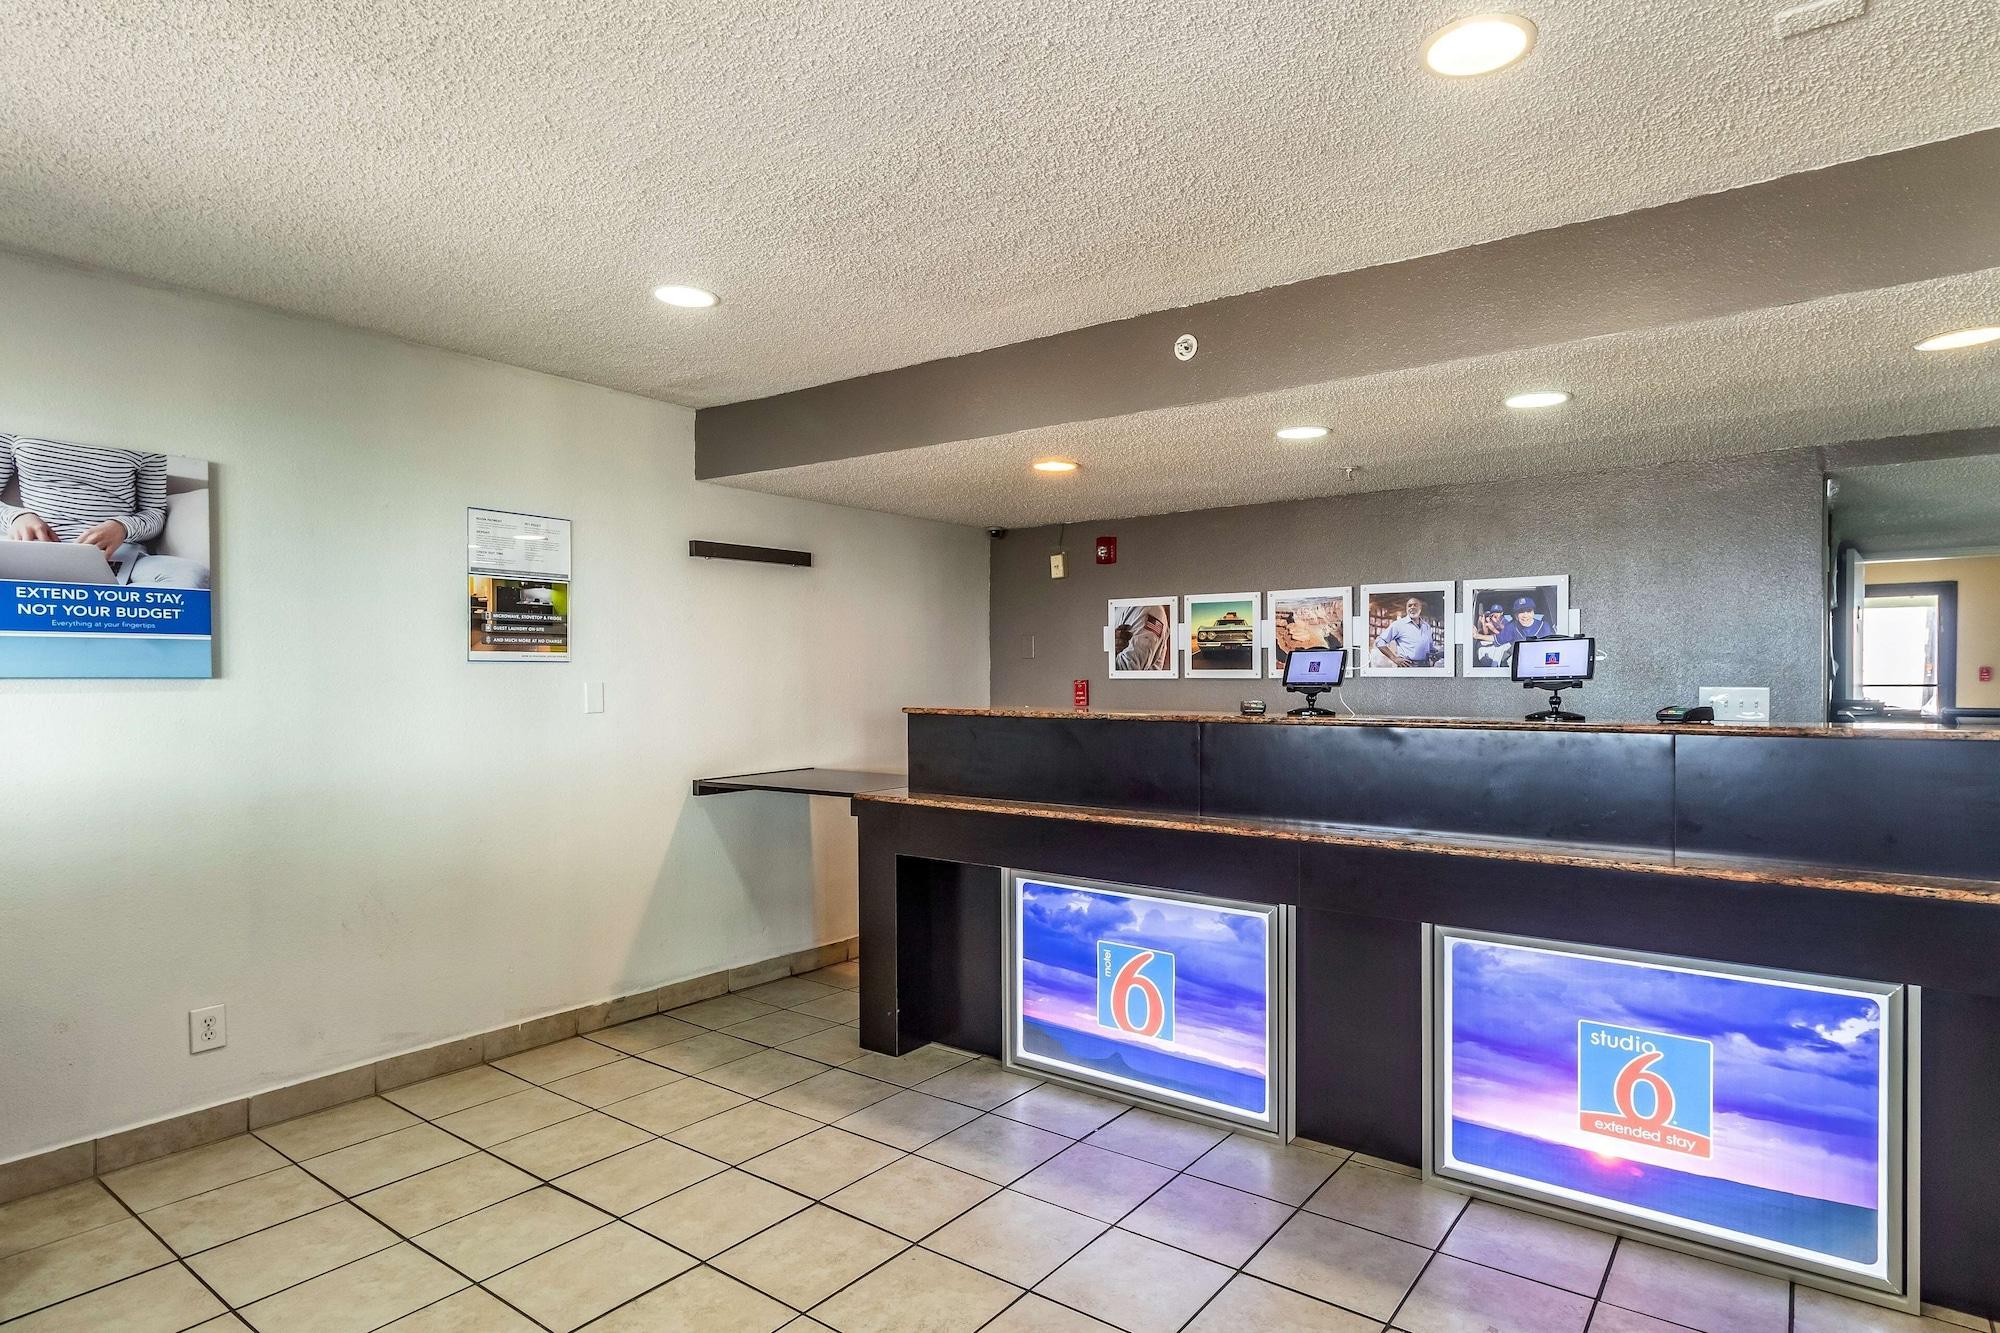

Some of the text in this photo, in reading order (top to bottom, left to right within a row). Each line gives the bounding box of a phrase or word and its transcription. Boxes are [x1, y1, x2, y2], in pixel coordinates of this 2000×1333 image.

[15, 586, 185, 605] EXTEND YOUR STAY,
[17, 603, 182, 619] NOT YOUR BUDGET
[51, 619, 92, 629] Everything
[121, 621, 156, 630] fingertips
[1103, 948, 1166, 1038] motel 6
[1590, 1029, 1658, 1054] studio
[1613, 1051, 1676, 1127] 6
[1594, 1119, 1697, 1152] extended stay
